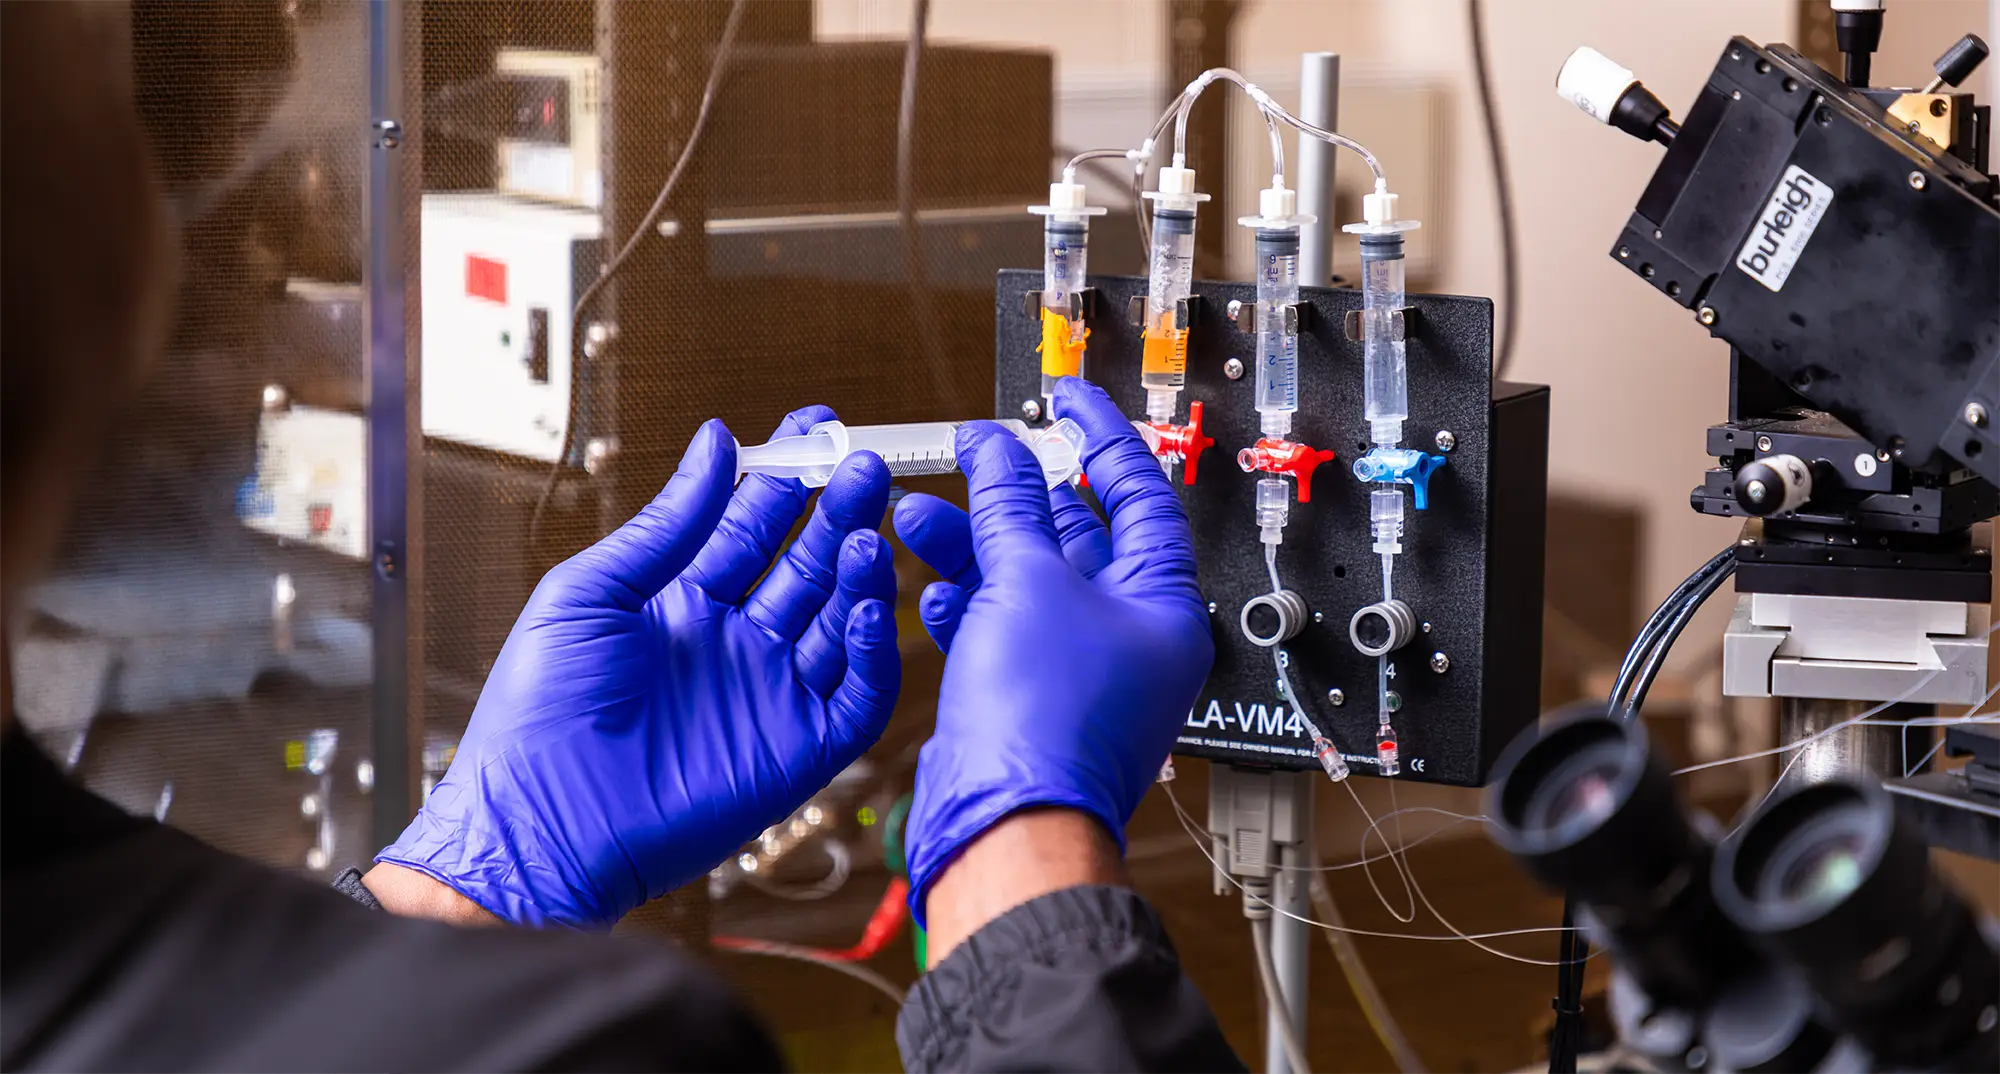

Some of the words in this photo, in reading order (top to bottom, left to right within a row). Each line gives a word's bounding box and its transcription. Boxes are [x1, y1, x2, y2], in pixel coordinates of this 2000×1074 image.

[1741, 174, 1815, 276] burleigh
[1269, 254, 1277, 264] 6
[1268, 355, 1276, 366] 2
[1278, 651, 1289, 668] 3
[1385, 662, 1397, 680] 4
[1184, 699, 1304, 738] LA-VM4
[1297, 749, 1311, 757] FOR
